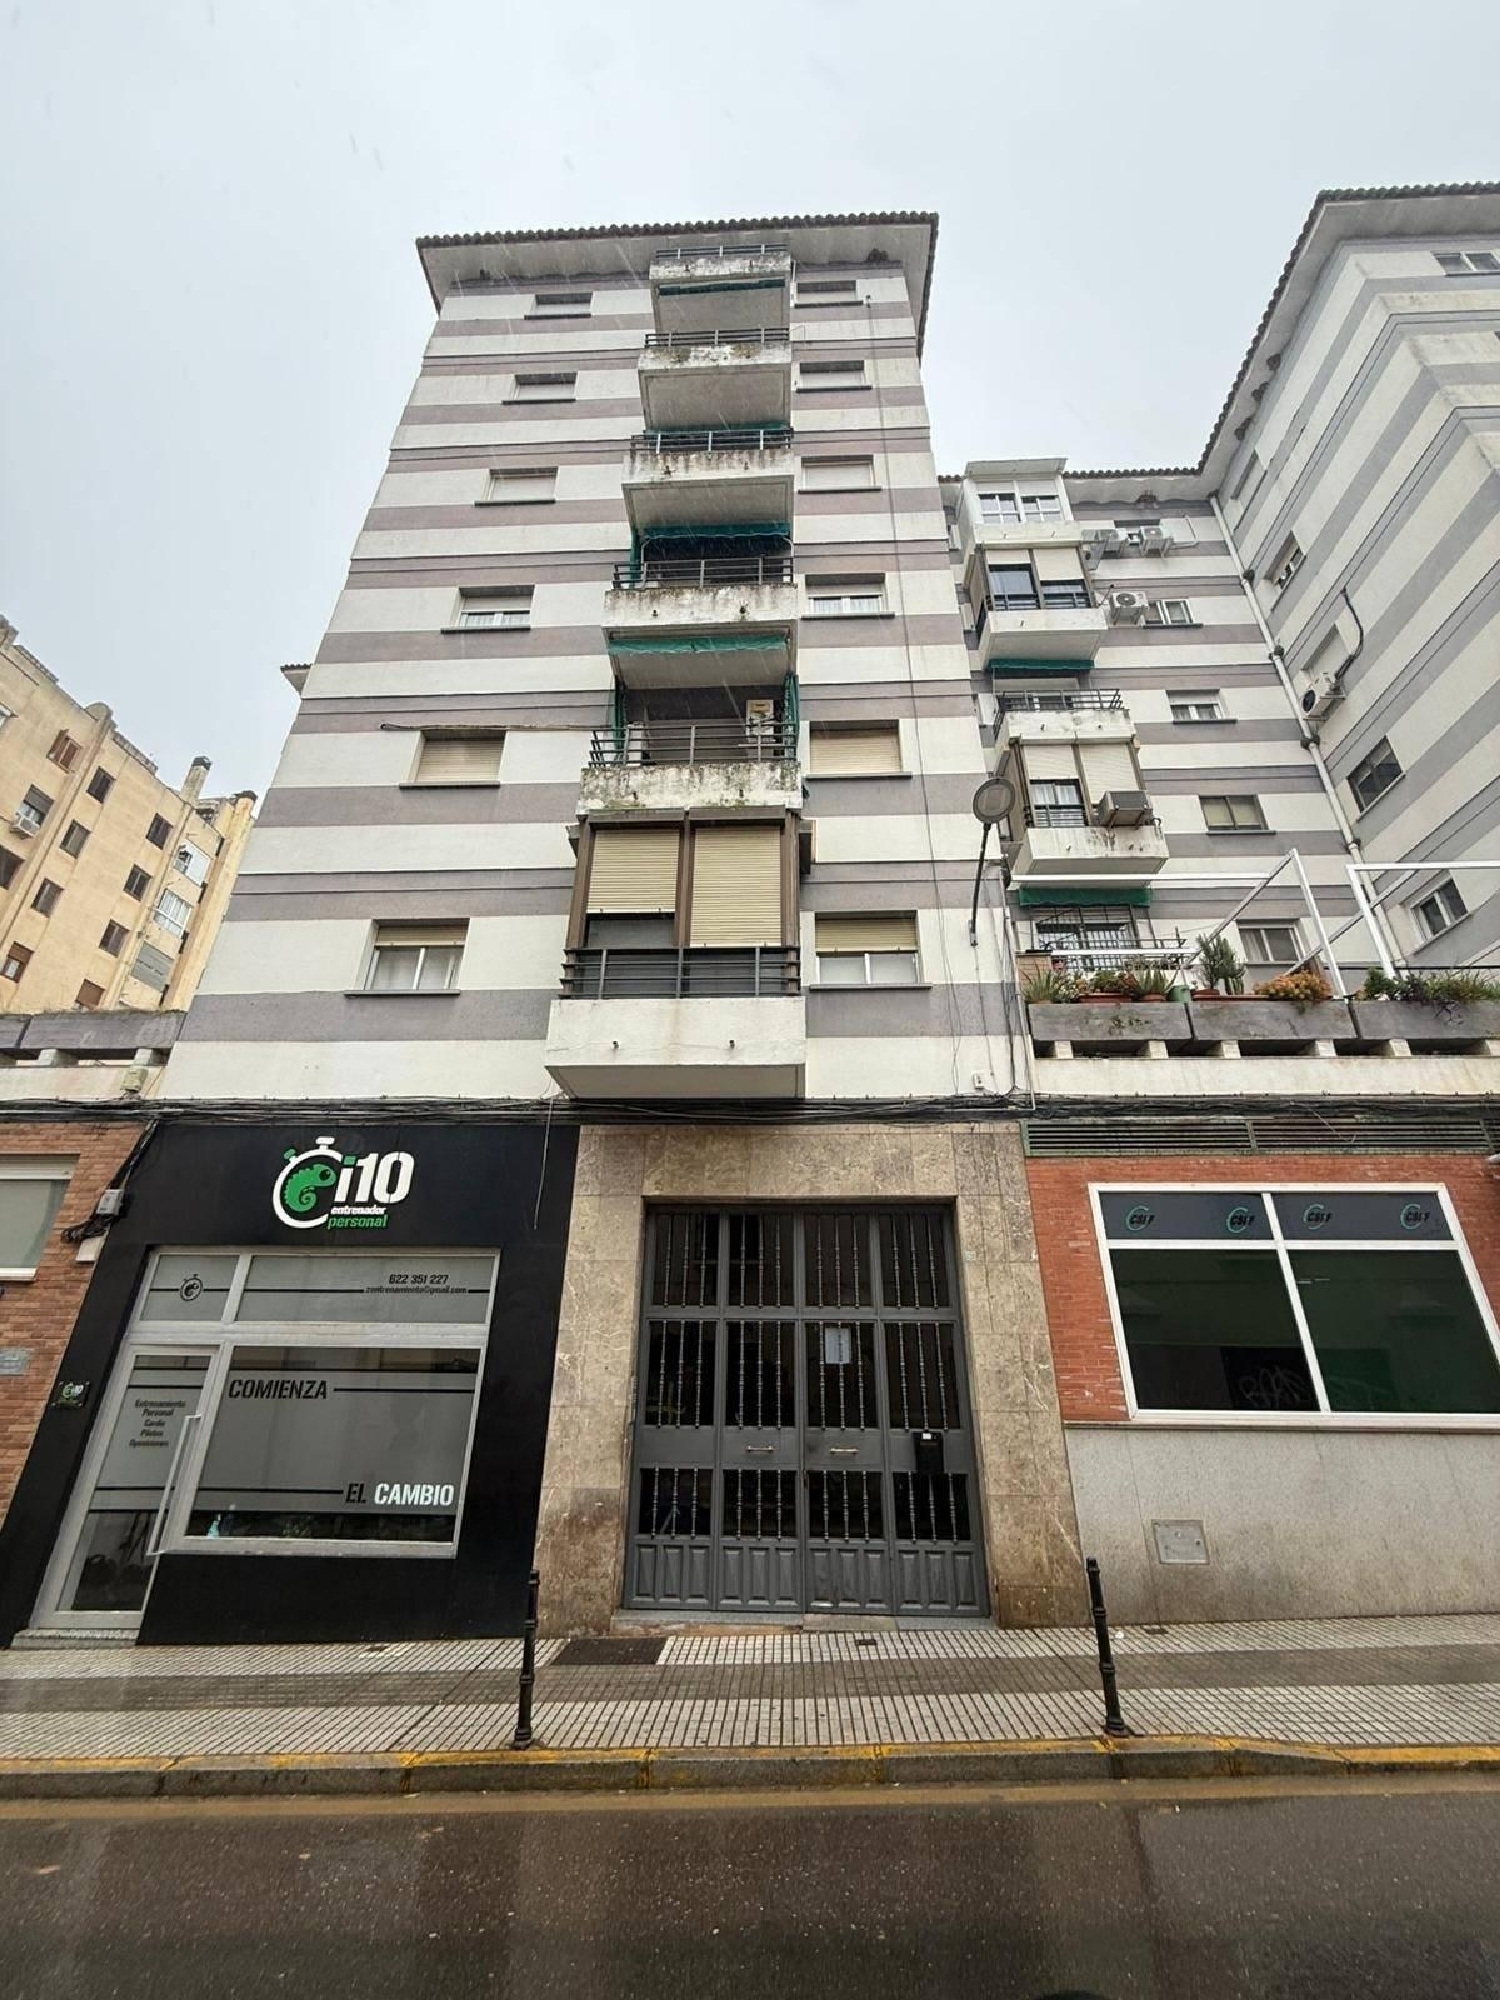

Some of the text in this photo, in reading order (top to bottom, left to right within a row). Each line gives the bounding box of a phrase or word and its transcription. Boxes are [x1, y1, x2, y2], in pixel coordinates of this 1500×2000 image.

[334, 1152, 415, 1204] i10
[330, 1204, 387, 1215] entrenador
[327, 1214, 388, 1229] personal
[389, 1274, 449, 1285] 622 351 227
[228, 1379, 327, 1400] COMIENZA
[345, 1483, 455, 1507] EL CAMBIO
